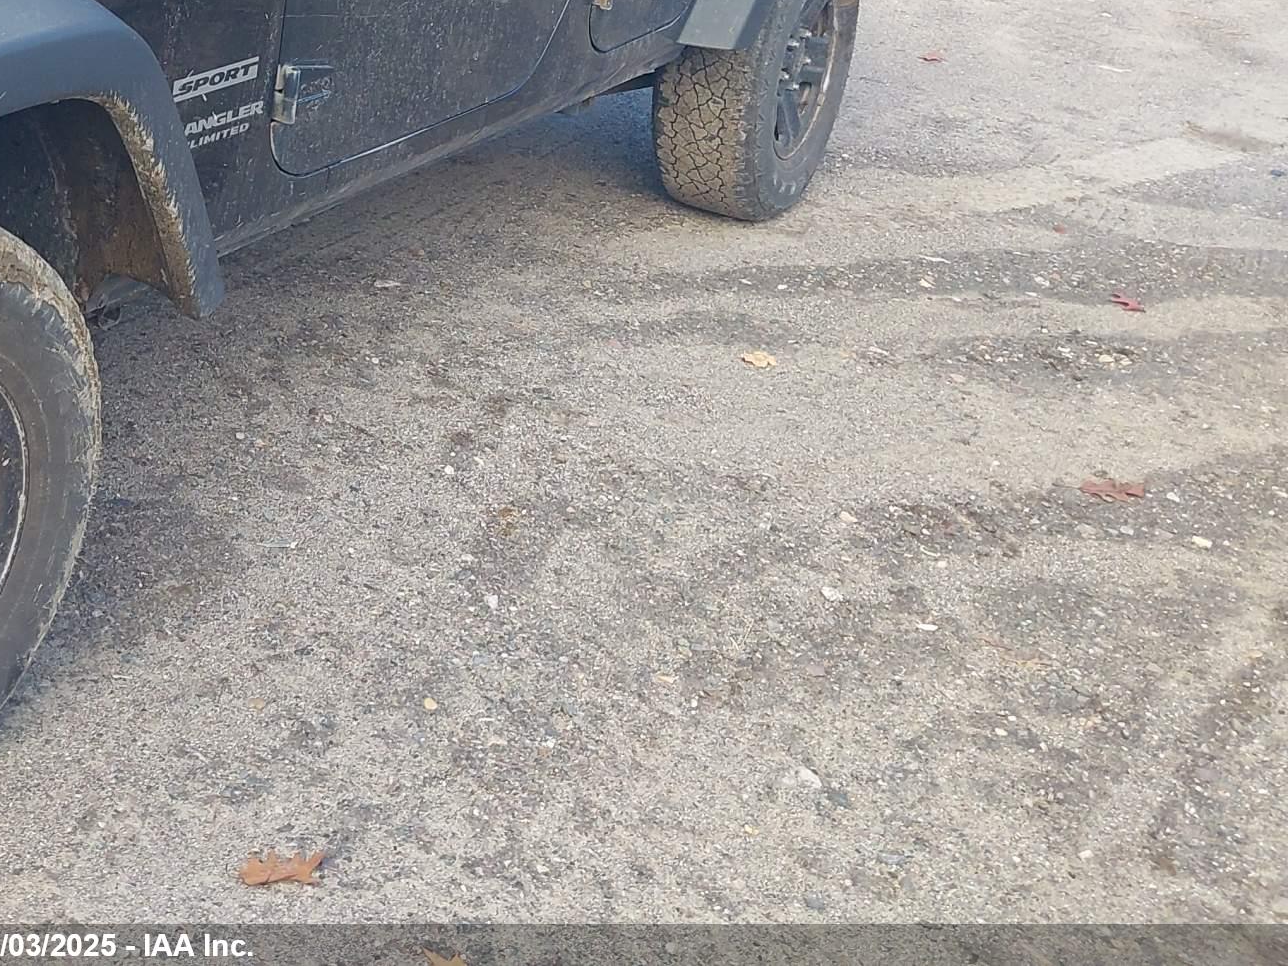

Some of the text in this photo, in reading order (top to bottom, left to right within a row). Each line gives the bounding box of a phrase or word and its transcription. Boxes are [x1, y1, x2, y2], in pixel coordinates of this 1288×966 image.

[178, 65, 252, 93] SPORT
[184, 100, 264, 136] ANGLER
[187, 122, 249, 149] LIMITED
